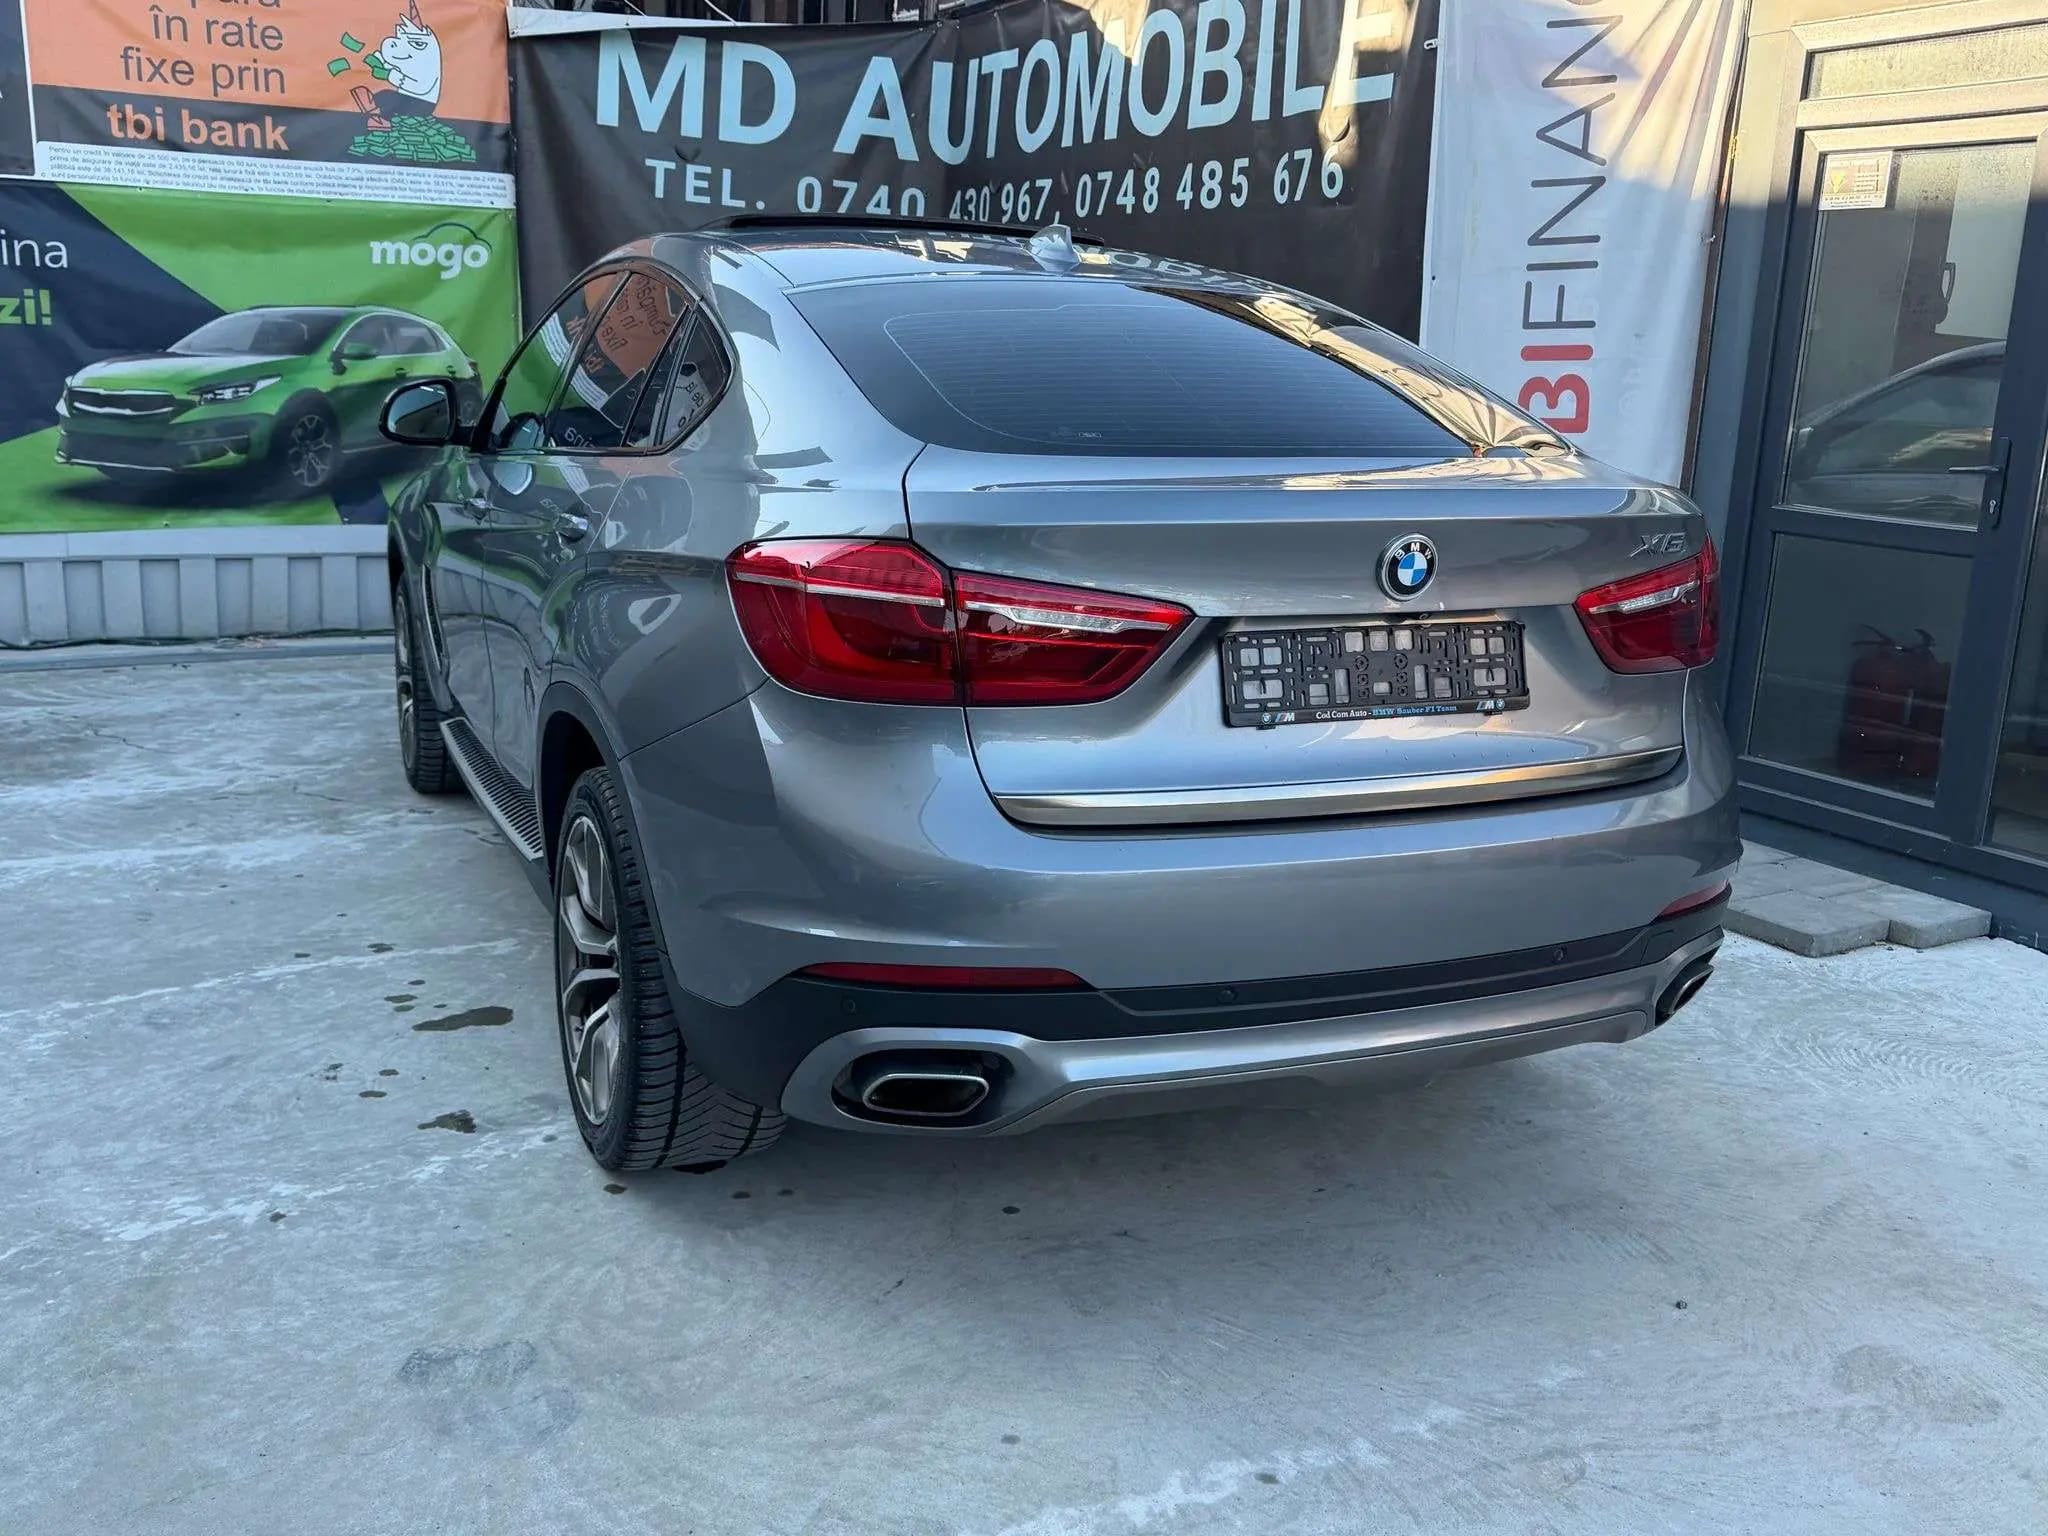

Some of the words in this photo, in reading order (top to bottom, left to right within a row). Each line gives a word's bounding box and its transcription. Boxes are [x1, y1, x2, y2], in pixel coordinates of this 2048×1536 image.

[149, 4, 189, 42] în
[205, 16, 283, 51] rate
[120, 46, 195, 86] fixe
[211, 58, 286, 97] prin
[596, 28, 797, 145] MD
[833, 0, 1399, 166] AUTOMOBILE
[107, 103, 166, 142] tbi
[181, 108, 290, 151] bank
[645, 158, 766, 210] TEL.
[796, 176, 926, 217] 0740
[949, 185, 991, 222] 430
[1075, 166, 1160, 219] 0748
[1176, 157, 1250, 211] 485
[1272, 144, 1345, 204] 676
[1517, 0, 1624, 434] BIFINAN
[370, 240, 489, 280] mogo
[0, 288, 52, 325] zi!
[1394, 541, 1433, 561] BMW
[1315, 710, 1331, 719] Cod
[1331, 710, 1349, 719] Com
[1349, 709, 1368, 718] Auto
[1372, 708, 1395, 717] BMW
[1436, 704, 1458, 713] Team
